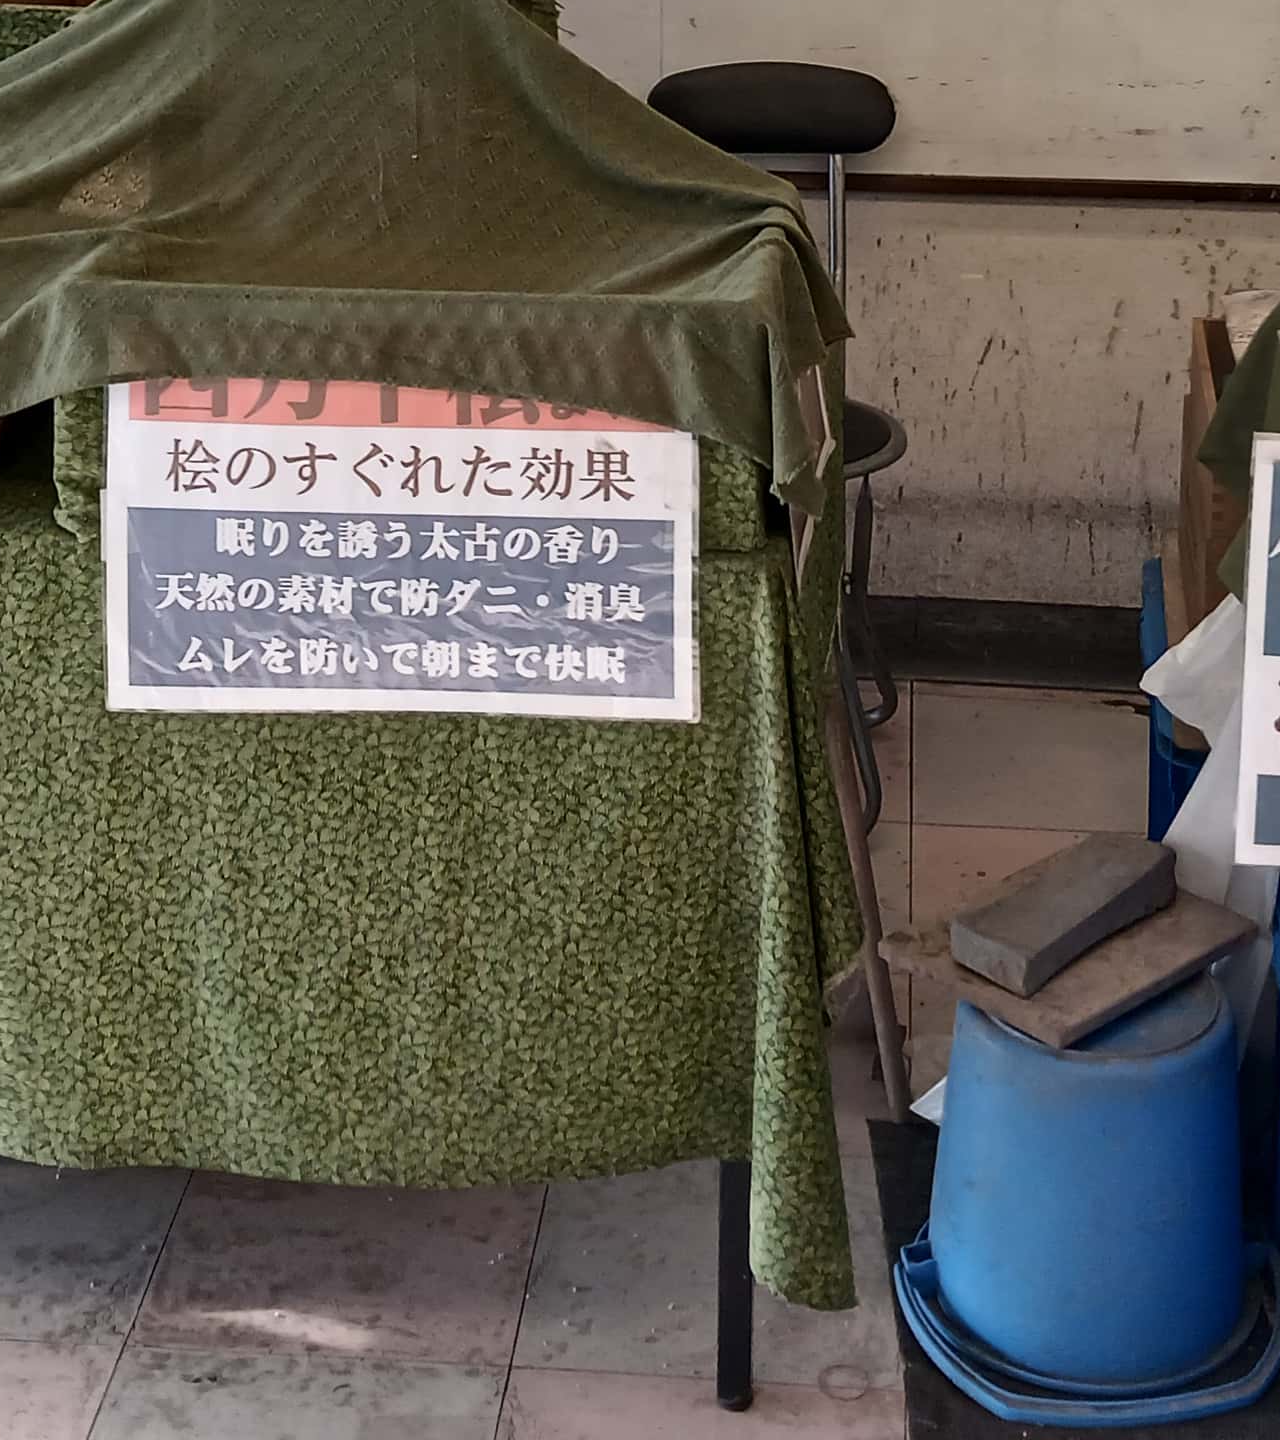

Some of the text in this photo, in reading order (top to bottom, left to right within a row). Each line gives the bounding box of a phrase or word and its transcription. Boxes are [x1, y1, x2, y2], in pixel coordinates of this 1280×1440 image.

[164, 437, 637, 504] 桧のすぐれた効果
[215, 517, 621, 567] 眠りを誘う太古の香り
[155, 571, 646, 623] 天然の素材で防ダニ・消臭
[176, 637, 627, 685] ムレを防いで朝まで快眠
